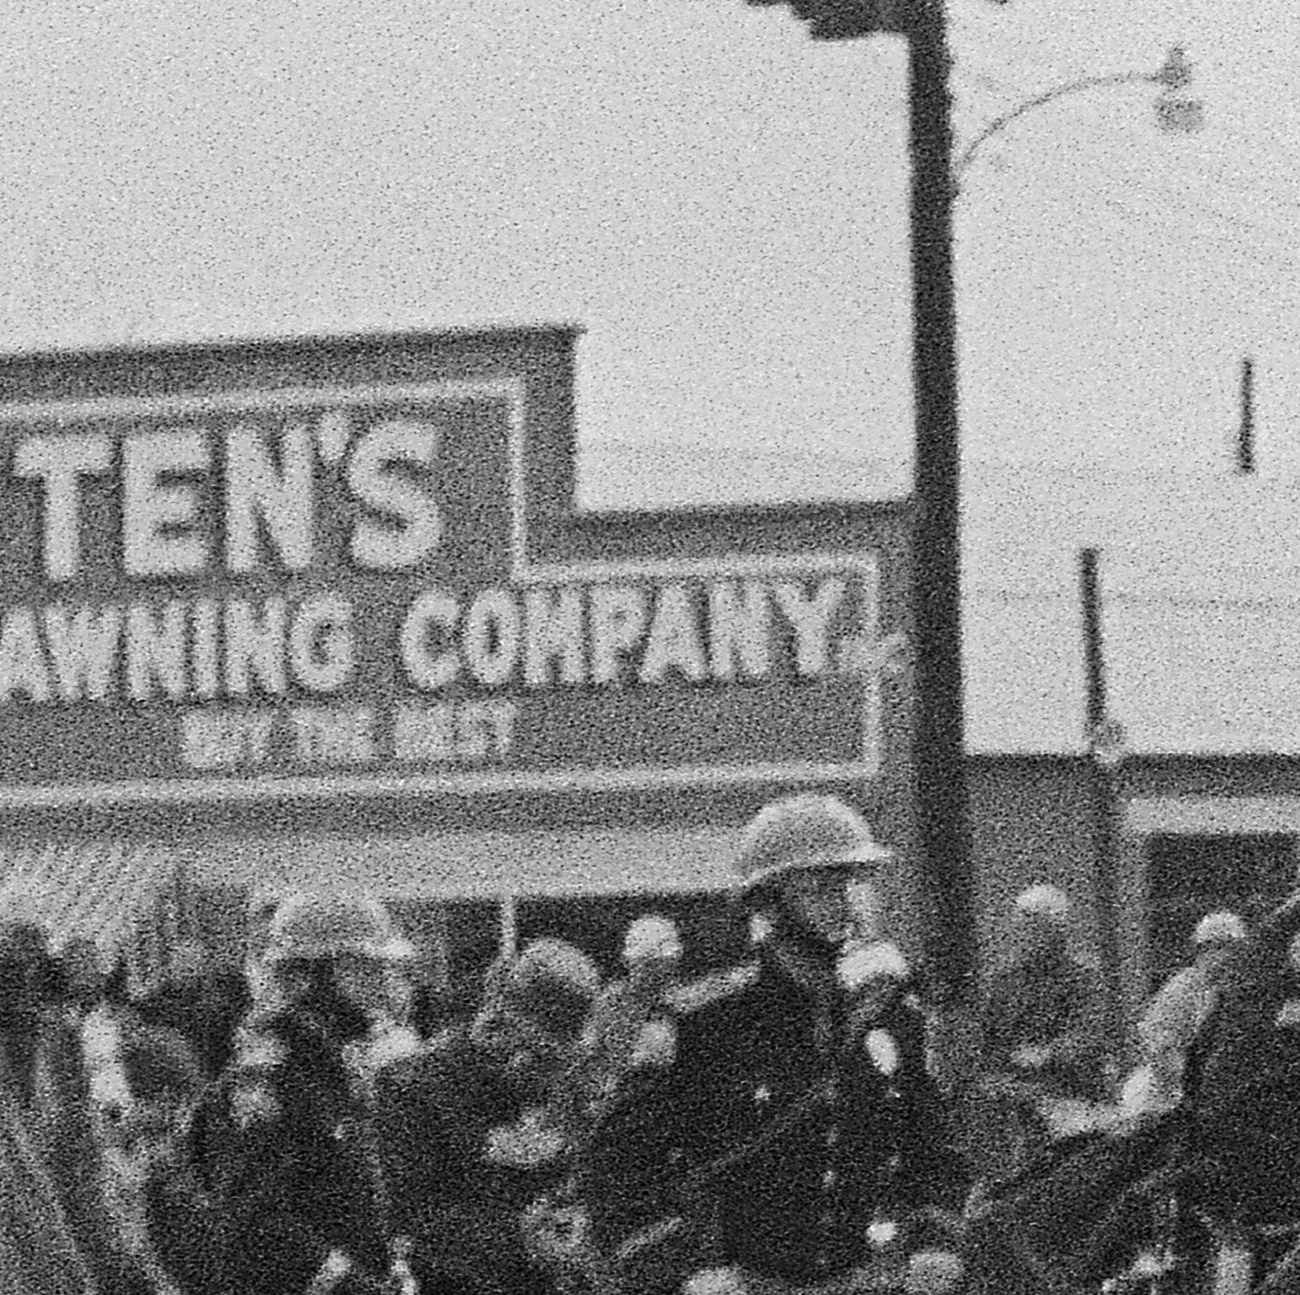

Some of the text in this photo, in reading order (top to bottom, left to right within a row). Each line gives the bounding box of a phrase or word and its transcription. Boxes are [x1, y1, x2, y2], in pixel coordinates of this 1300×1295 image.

[398, 577, 845, 688] COMPANY
[181, 701, 518, 769] BUY THE BEST
